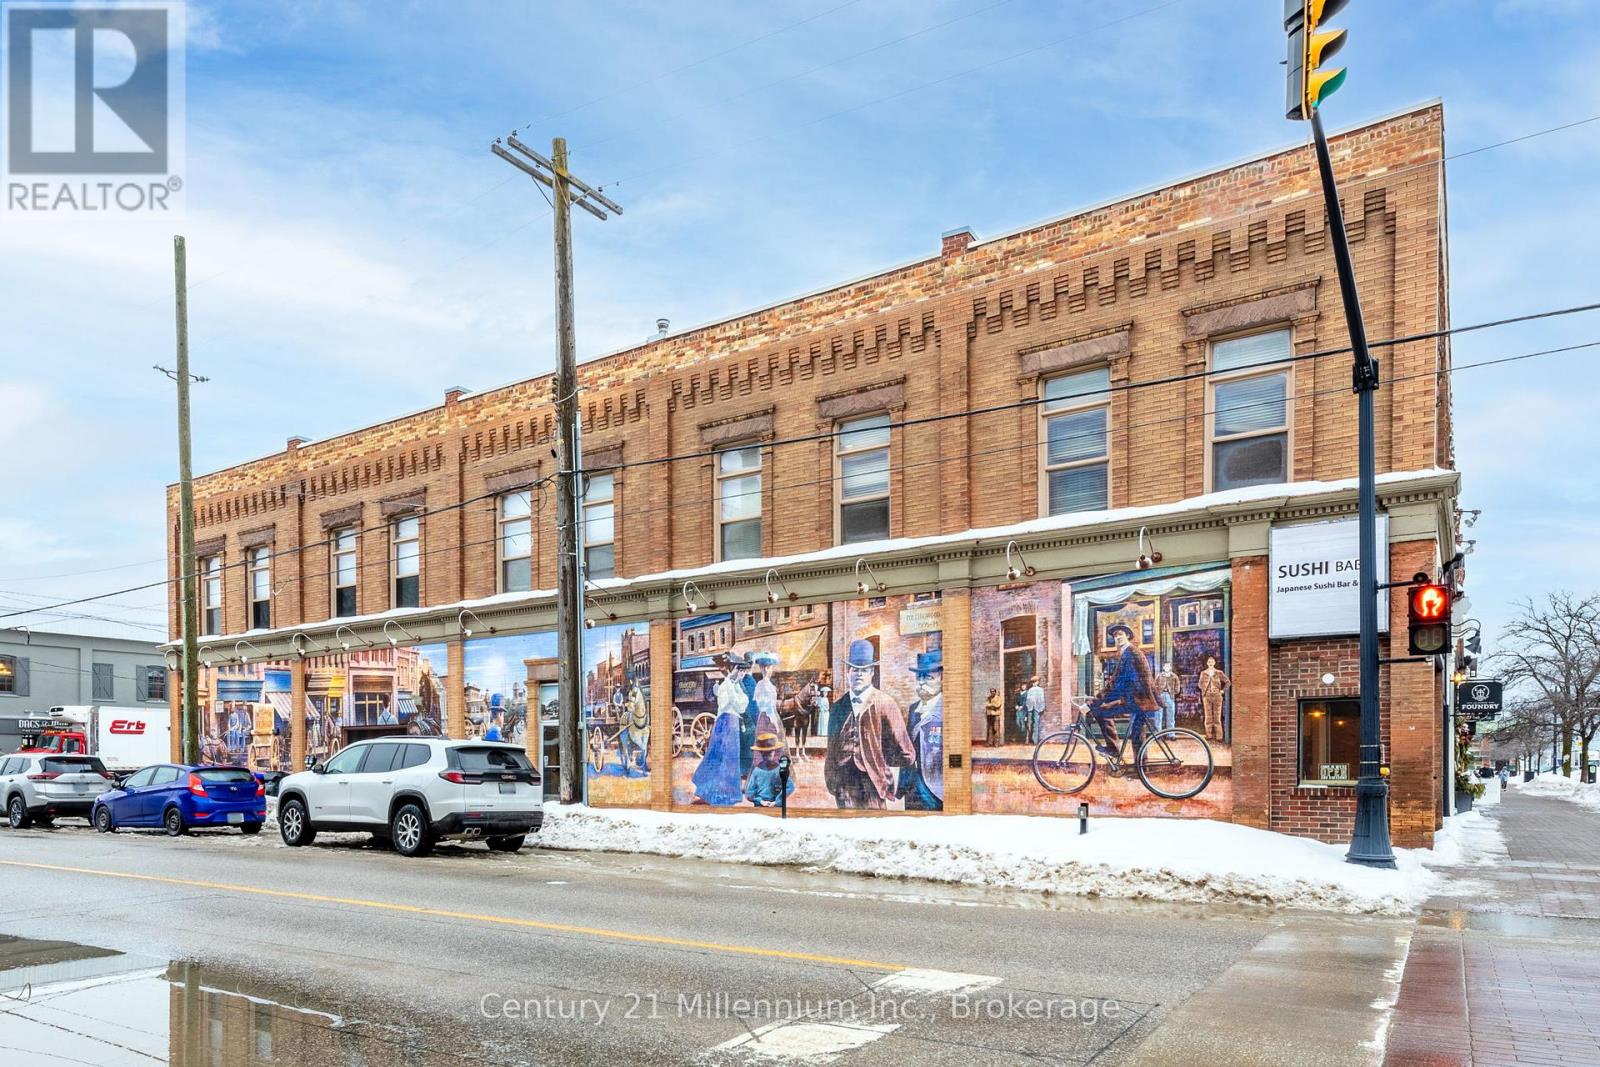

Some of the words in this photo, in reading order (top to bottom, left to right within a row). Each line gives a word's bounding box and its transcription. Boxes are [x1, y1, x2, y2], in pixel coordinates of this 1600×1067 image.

[1278, 561, 1329, 578] SUSHI
[1276, 584, 1312, 594] Japanese
[1313, 581, 1335, 590] Sushi
[1352, 579, 1359, 587] &
[110, 720, 146, 734] Erb
